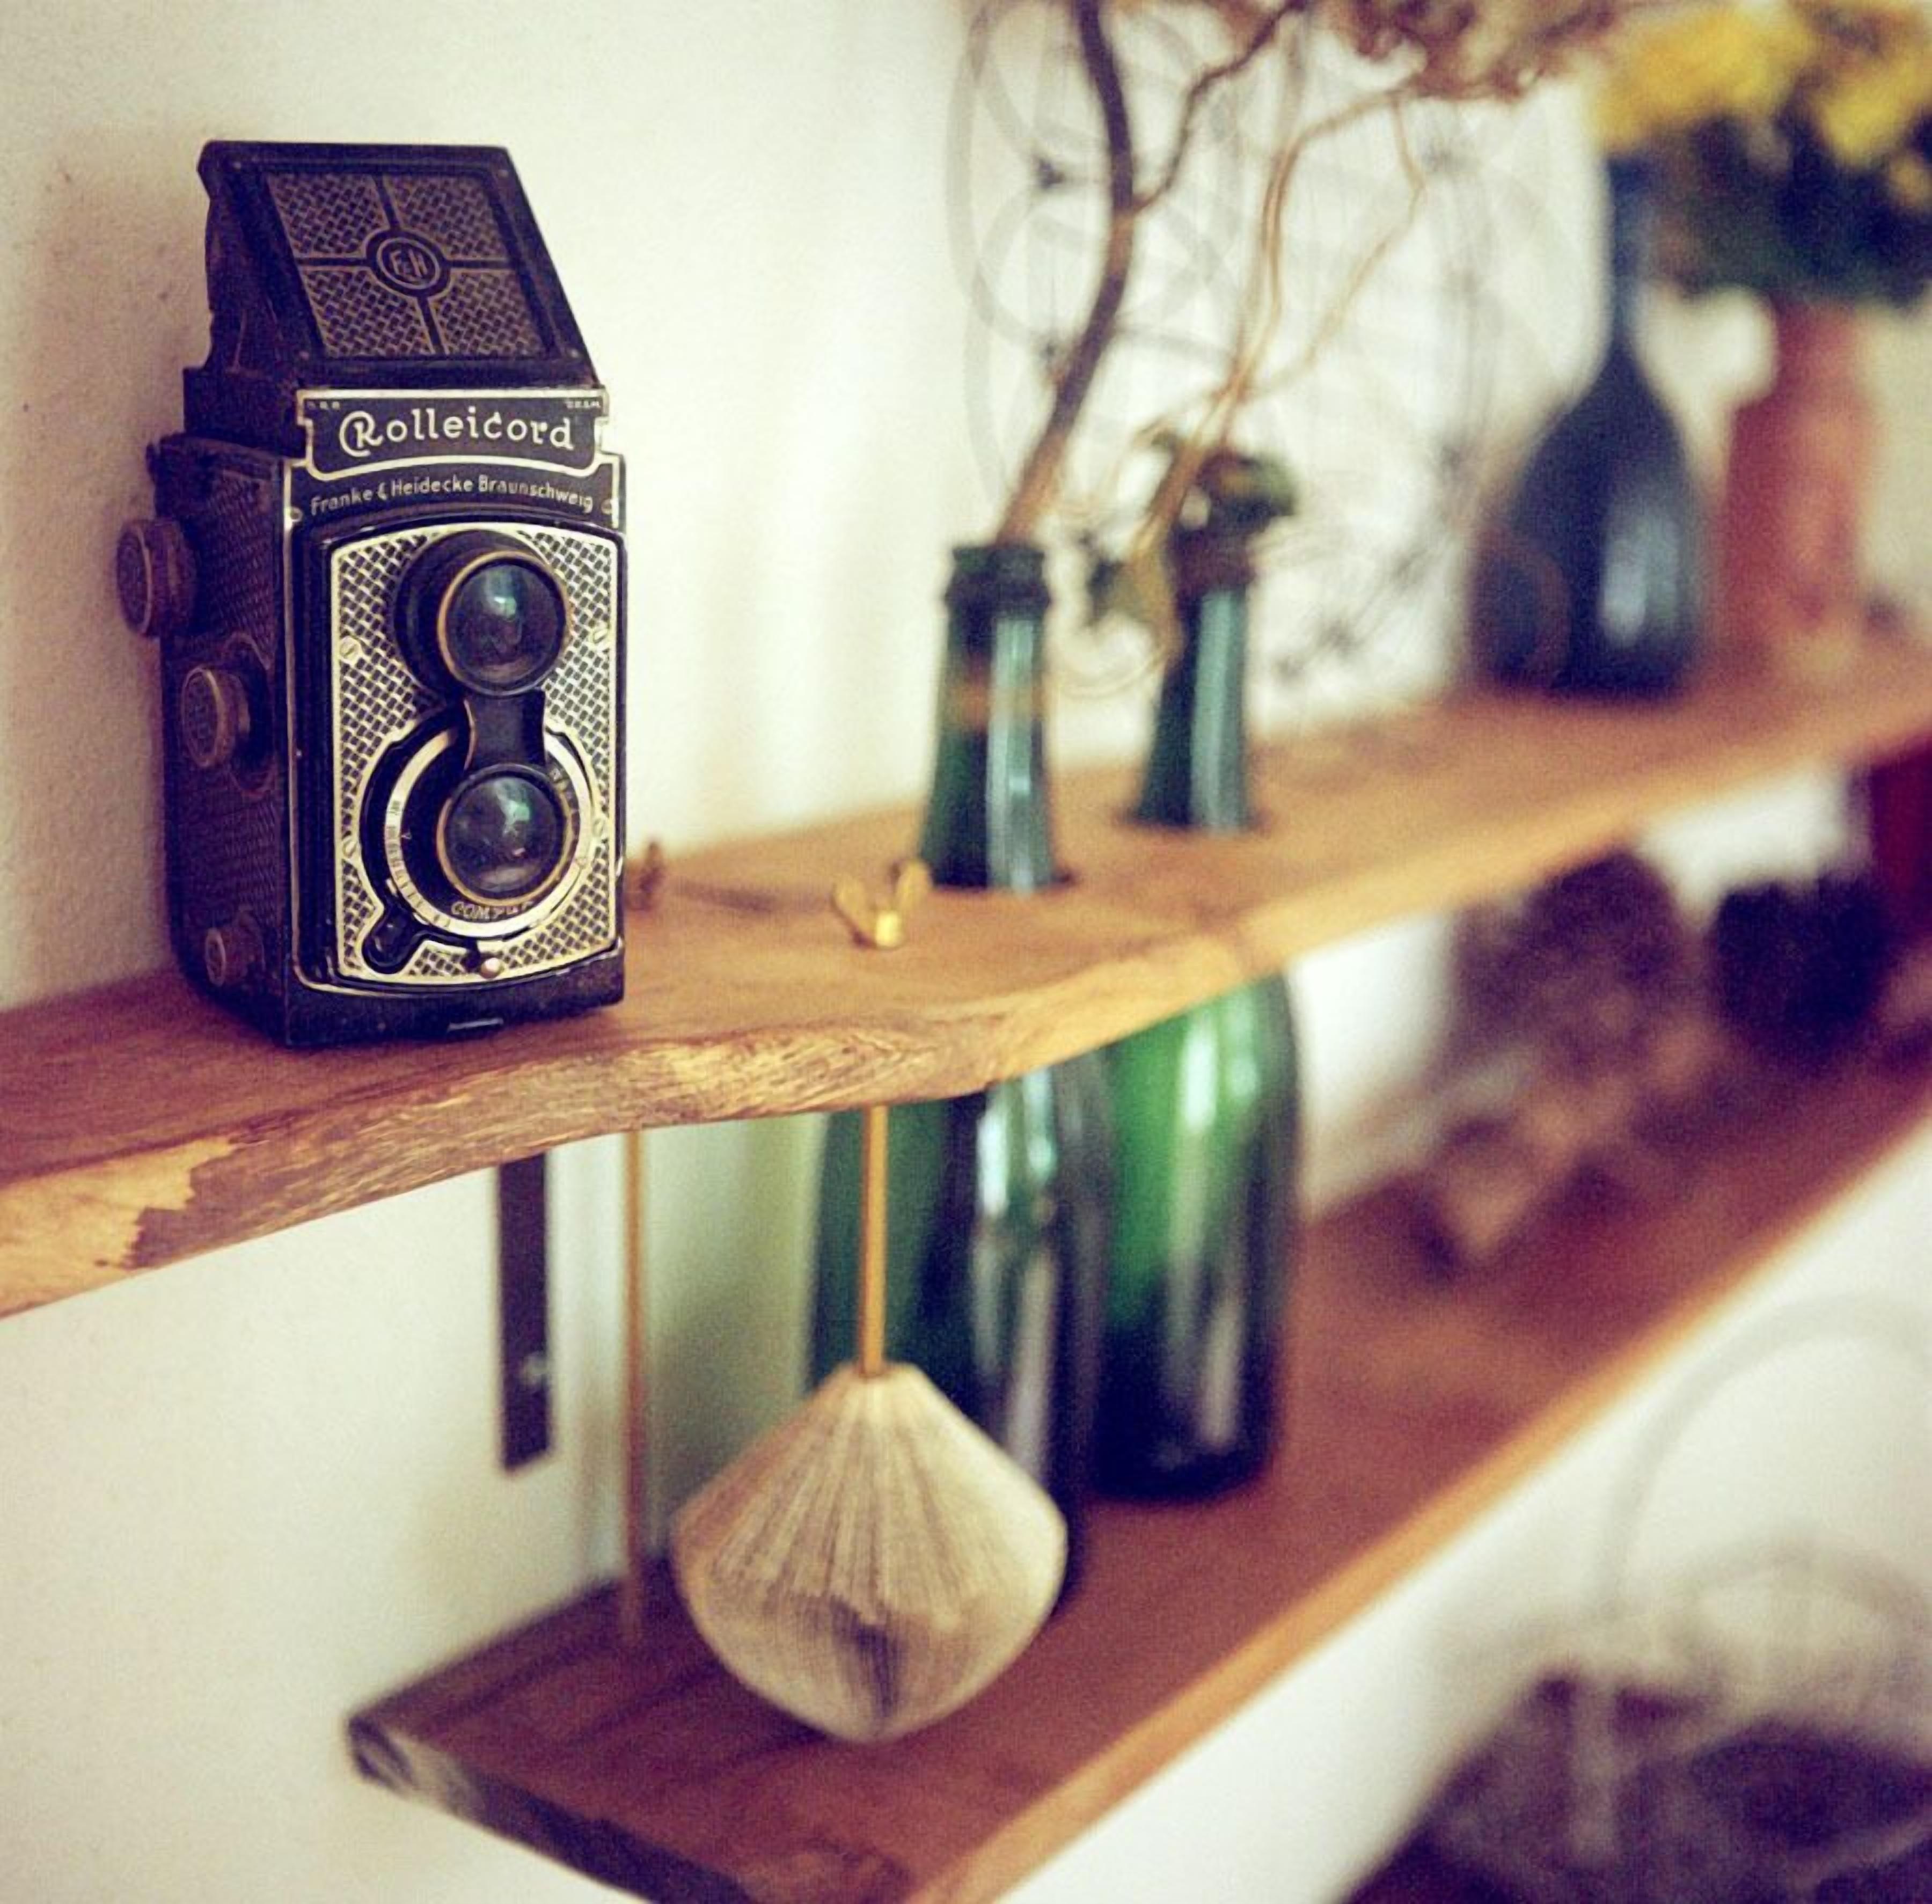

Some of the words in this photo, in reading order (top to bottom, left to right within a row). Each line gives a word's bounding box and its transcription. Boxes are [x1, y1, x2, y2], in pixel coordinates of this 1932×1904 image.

[339, 406, 574, 457] Rolleicord
[311, 487, 373, 516] Franke
[391, 474, 473, 497] Heidecke
[478, 474, 593, 514] Braunschweig
